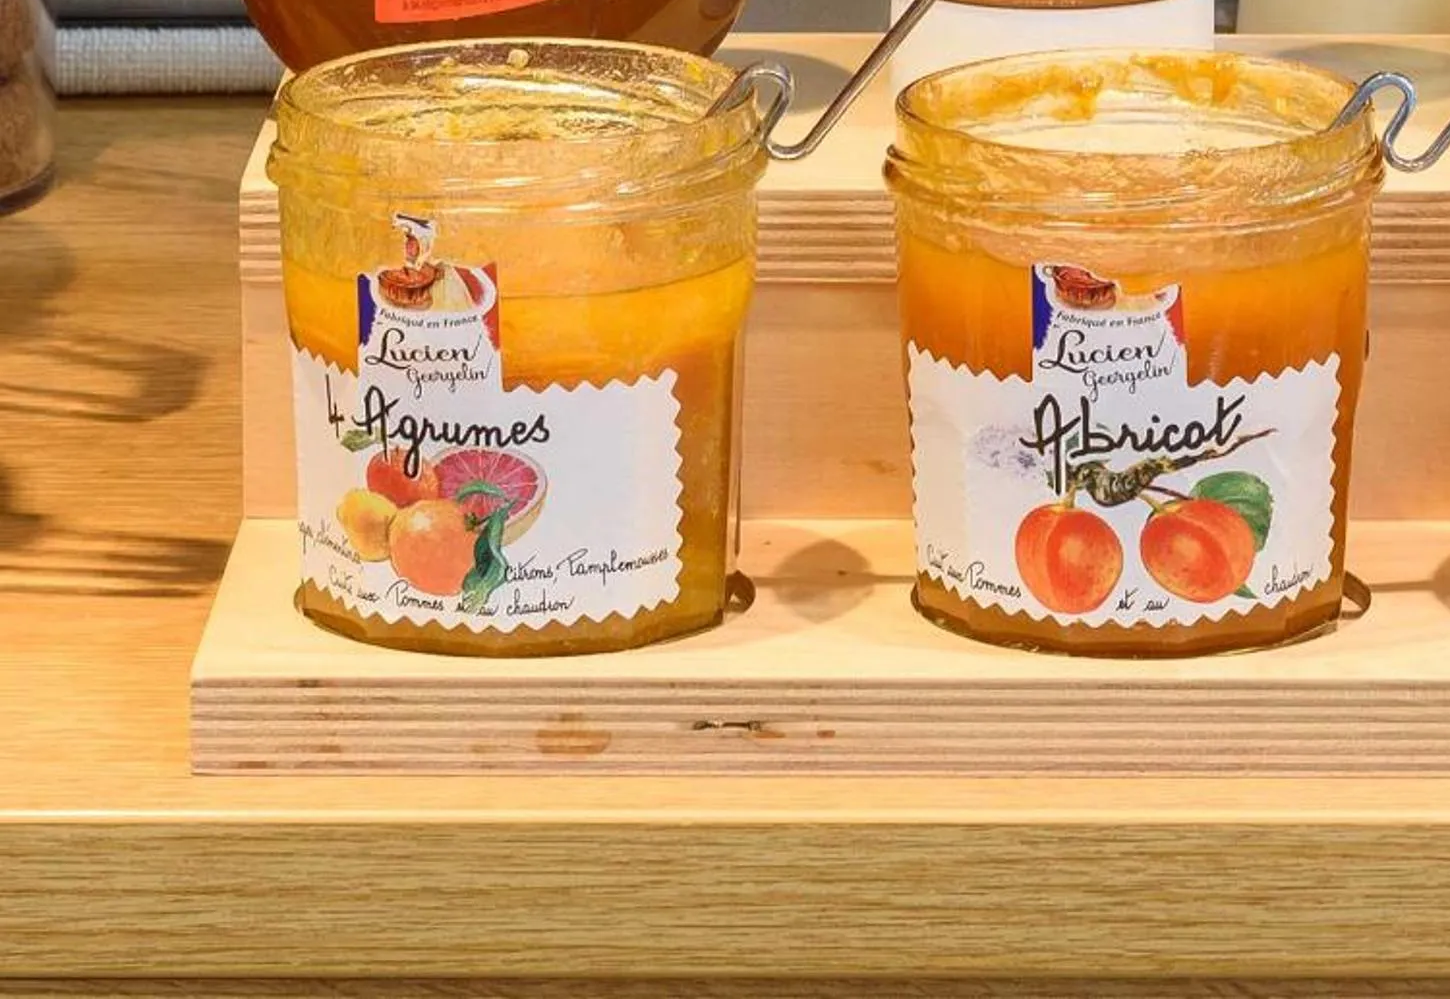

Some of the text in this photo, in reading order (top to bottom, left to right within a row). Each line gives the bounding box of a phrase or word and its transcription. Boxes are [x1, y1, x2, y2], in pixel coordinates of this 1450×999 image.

[364, 327, 482, 370] Lucien
[1037, 328, 1167, 374] Lucien
[407, 353, 494, 399] Georgelin
[1082, 350, 1177, 402] Georgelin
[325, 373, 550, 480] 4 Agrumes
[1019, 394, 1246, 496] Abricot
[385, 578, 445, 612] Pommes
[965, 561, 1022, 598] Pommes
[1115, 588, 1139, 612] et
[1144, 597, 1170, 612] au
